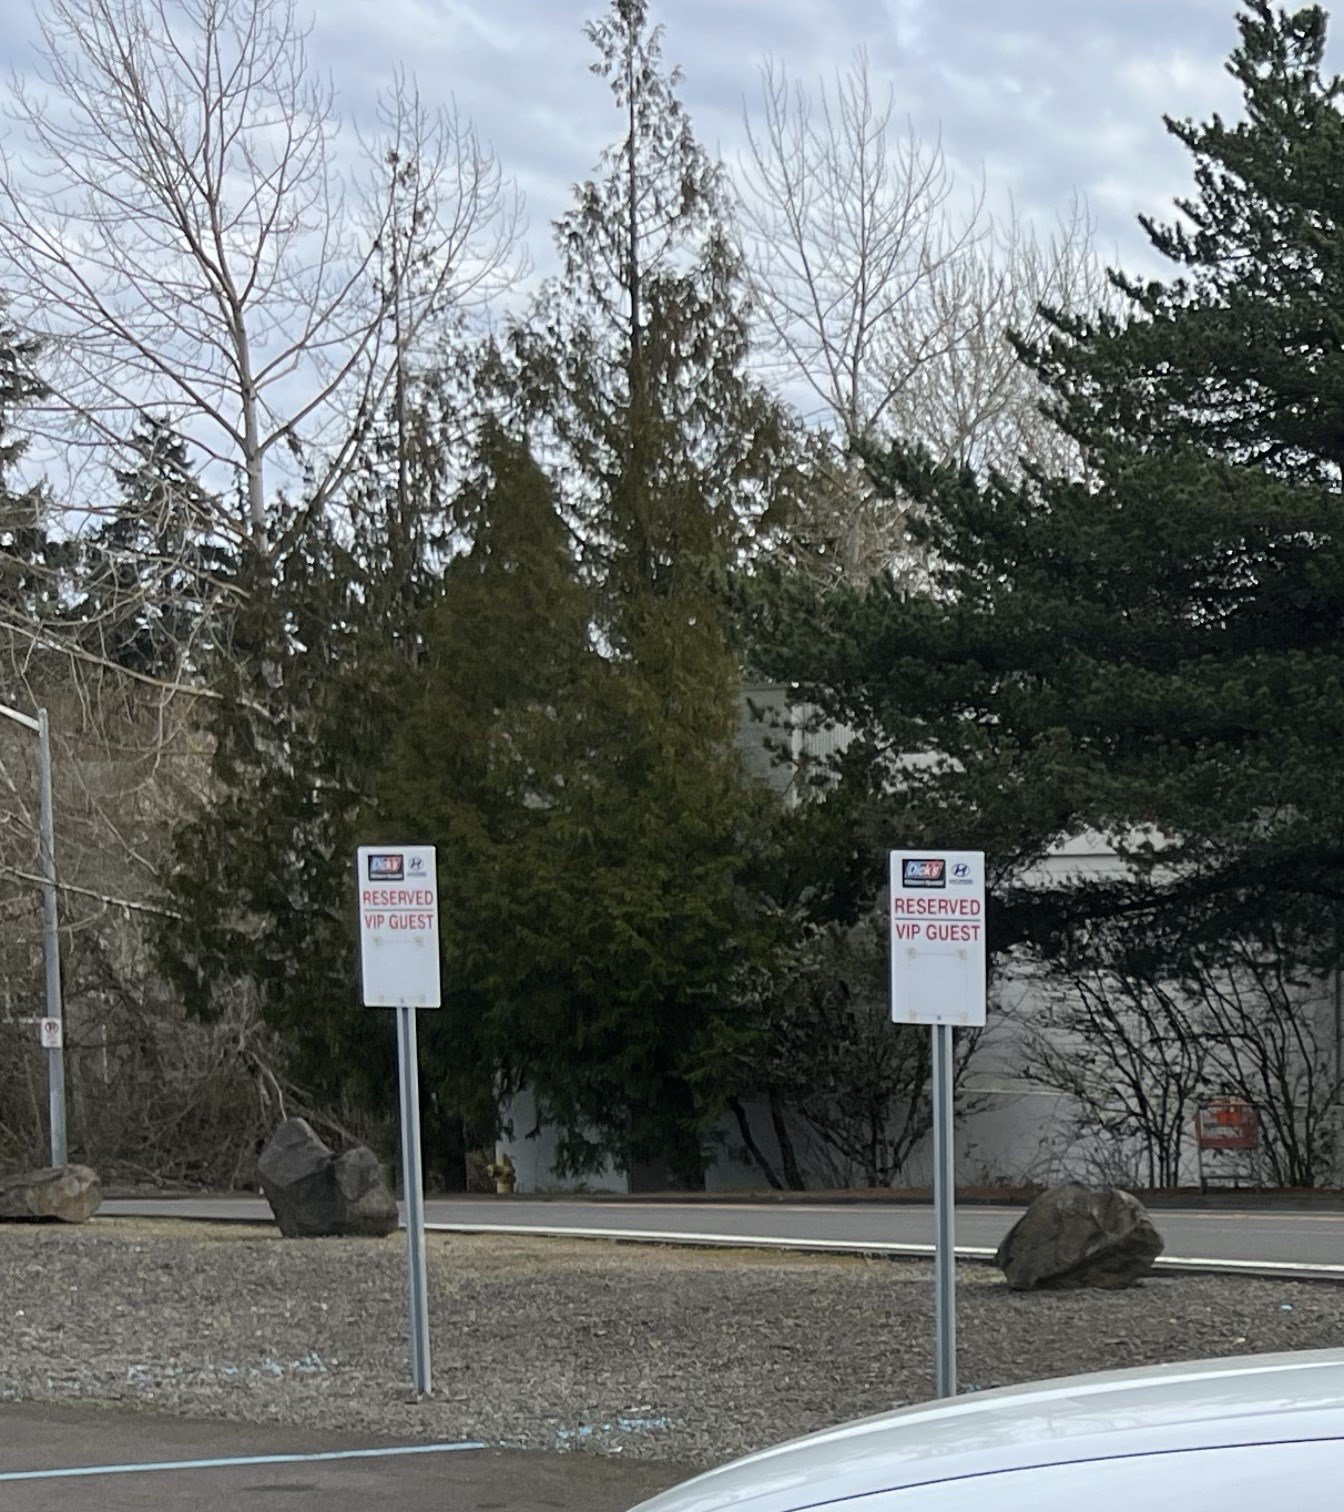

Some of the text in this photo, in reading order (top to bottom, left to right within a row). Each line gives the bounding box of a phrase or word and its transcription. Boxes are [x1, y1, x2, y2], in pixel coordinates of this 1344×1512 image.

[363, 890, 434, 906] RESERVED
[894, 898, 981, 916] RESERVED
[364, 914, 434, 930] VIP GUEST
[895, 923, 981, 942] VIP GUEST
